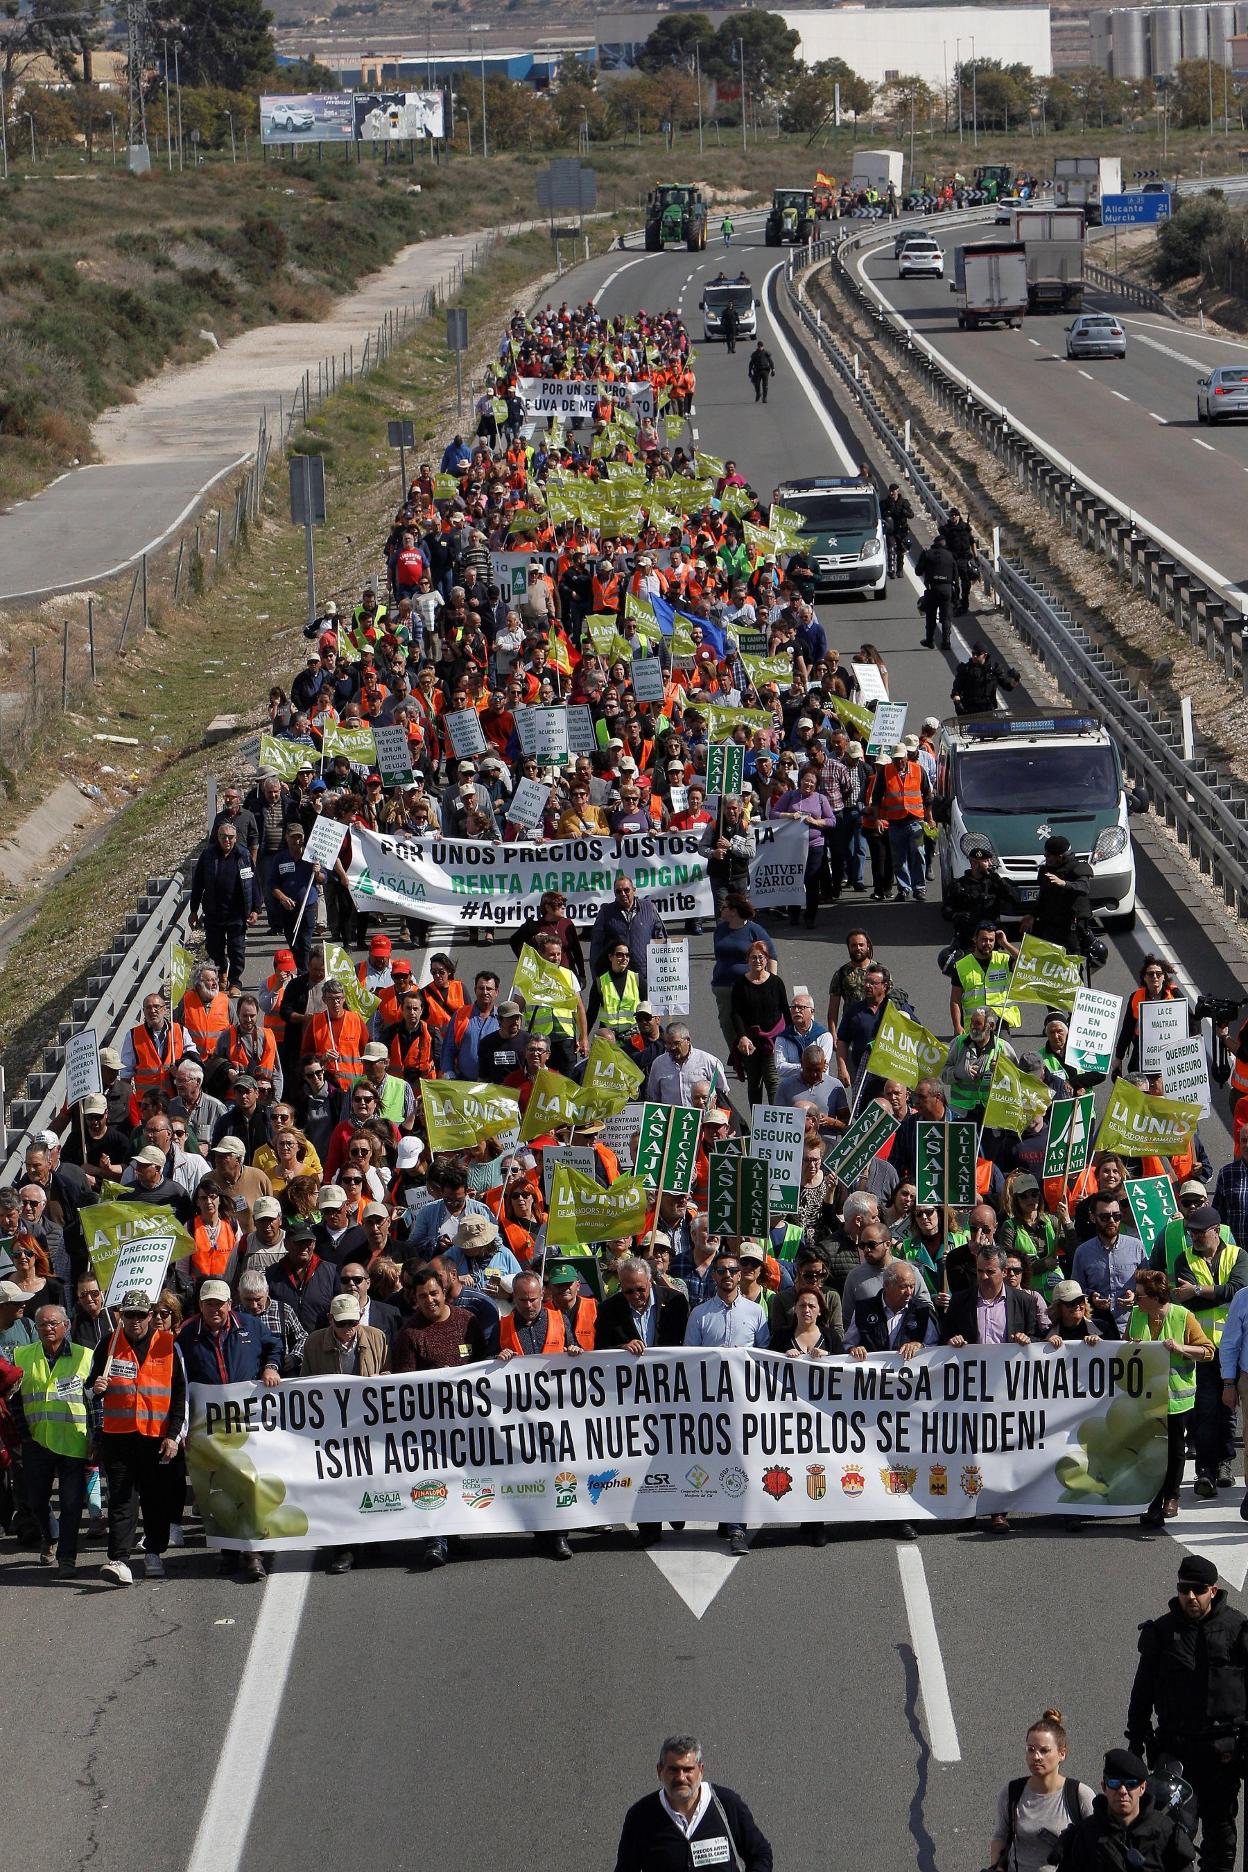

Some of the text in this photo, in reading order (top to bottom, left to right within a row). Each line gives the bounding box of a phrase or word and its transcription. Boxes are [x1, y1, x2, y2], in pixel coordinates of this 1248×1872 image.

[1105, 205, 1143, 213] Alicante
[542, 383, 626, 397] POR UN SEURO
[535, 400, 575, 411] UVA DE
[710, 748, 723, 793] ASAJA
[731, 748, 740, 793] ALICANTE
[381, 836, 699, 864] POR UNOS PRECIOS JUSTOS
[378, 877, 426, 896] ASAJA
[451, 874, 522, 895] RENTA
[635, 864, 703, 888] DIGNA
[756, 876, 795, 888] SARIO
[651, 946, 684, 954] QUEREMOS
[1018, 954, 1037, 972] LA
[1080, 992, 1118, 1008] PRECIOS
[1077, 1002, 1116, 1019] MÍNIMOS
[1088, 1018, 1100, 1027] EN
[1152, 1020, 1178, 1028] MALTRATA
[881, 1024, 894, 1044] LA
[1076, 1026, 1108, 1040] CAMPO
[1084, 1040, 1095, 1050] YA
[1166, 1043, 1198, 1060] QUEREMOS
[594, 1062, 614, 1078] LA
[1166, 1060, 1202, 1076] UN SEGURO
[1165, 1074, 1208, 1093] QUE PODAMOS
[432, 1100, 455, 1117] LA
[536, 1092, 560, 1112] LA
[764, 1111, 794, 1124] ESTE
[1111, 1102, 1128, 1125] LA
[754, 1128, 801, 1144] SEGURO
[828, 1108, 882, 1172] ASAJA
[642, 1108, 667, 1187] ASAJA
[673, 1112, 694, 1190] ALICANTE
[758, 1148, 793, 1162] ES UN
[843, 1122, 894, 1182] ALICANTE
[1050, 1145, 1084, 1160] ASJA
[923, 1126, 944, 1202] ASAJA
[958, 1126, 970, 1203] ALICANTE
[558, 1186, 576, 1206] LA
[714, 1158, 736, 1234] ASAJA
[751, 1162, 764, 1236] ALICANTE
[1132, 1183, 1156, 1240] ASAJ
[123, 1243, 167, 1256] PRECIOS
[116, 1278, 152, 1288] CAMPO
[206, 1348, 1152, 1434] PRECIOS Y SEGUROS JUSTOS PARA LA UVA DE MESA DEL VINALOPÓ.
[314, 1410, 1046, 1480] ¡SIN AGRICULTURA NUESTROS PUEBLOS SE HUNDEN!
[589, 1477, 631, 1490] fexphal
[644, 1473, 671, 1485] CSR
[501, 1485, 513, 1494] LA
[373, 1493, 400, 1504] ASAJA
[556, 1494, 578, 1508] UPA
